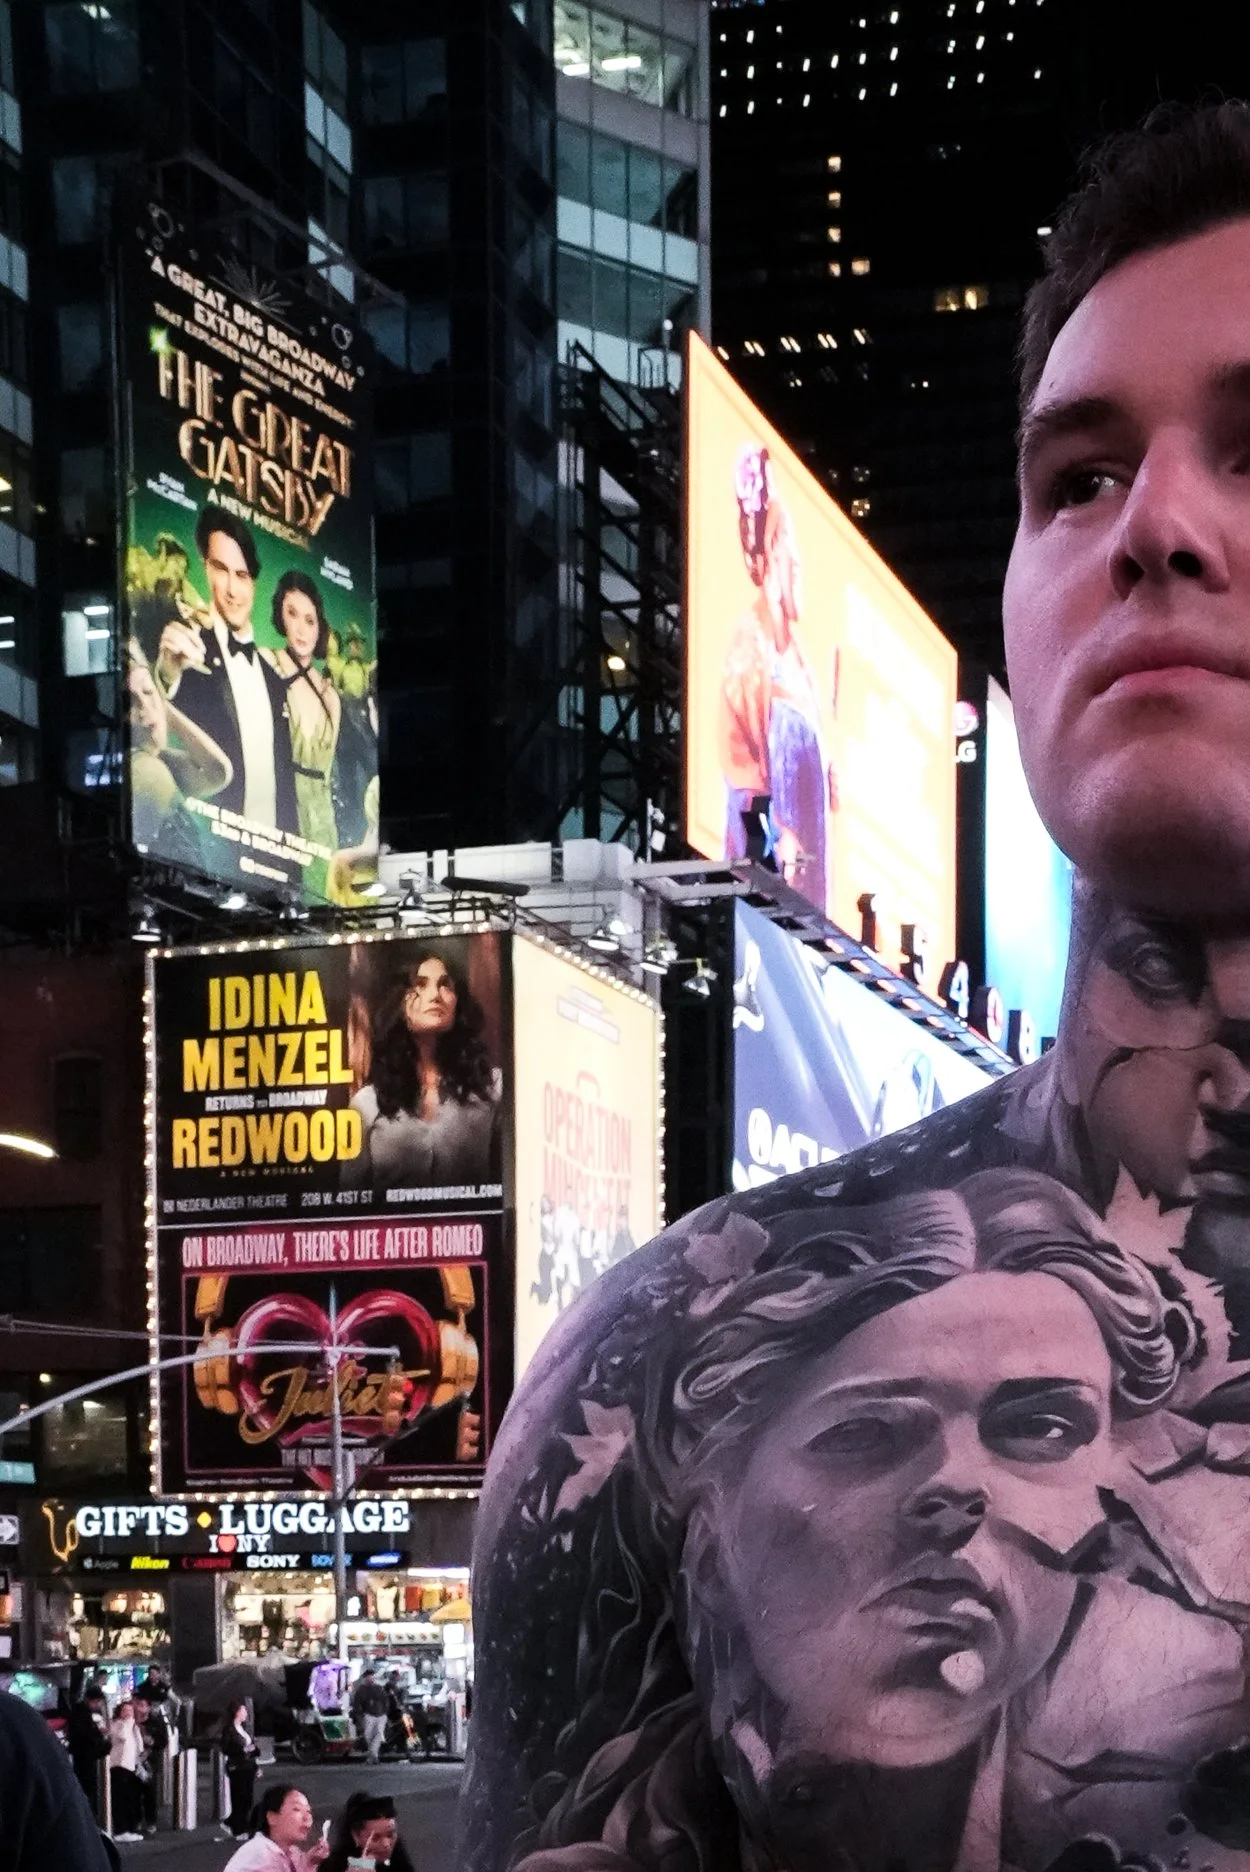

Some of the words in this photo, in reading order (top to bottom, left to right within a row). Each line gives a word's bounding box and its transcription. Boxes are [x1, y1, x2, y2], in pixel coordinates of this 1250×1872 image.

[167, 264, 230, 318] GREAT,
[233, 303, 265, 338] BIG
[267, 324, 356, 391] BROADWAY
[194, 302, 326, 396] EXTRAVAGANZA
[158, 347, 225, 430] THE
[232, 390, 352, 498] GREAT
[178, 418, 335, 536] GATSBY
[208, 970, 328, 1031] IDINA
[182, 1029, 355, 1093] MENZEL
[205, 1095, 256, 1113] RETURNS
[268, 1089, 328, 1108] BROADWAY
[543, 1080, 633, 1176] OPERATION
[172, 1108, 363, 1169] REDWOOD
[176, 1195, 245, 1213] NEDERLANDER
[247, 1193, 289, 1208] THEATRE
[360, 1189, 374, 1203] ST
[386, 1184, 503, 1203] REDWOODMUSICAL.COM
[182, 1236, 204, 1268] ON
[206, 1232, 289, 1267] BROADWAY,
[293, 1229, 350, 1263] THERE'S
[353, 1228, 381, 1260] LIFE
[383, 1226, 429, 1259] AFTER
[432, 1224, 484, 1257] ROMEO
[75, 1505, 189, 1537] GIFTS
[219, 1500, 410, 1534] LUGGAGE
[236, 1533, 271, 1553] NY
[130, 1556, 170, 1570] Nikon
[246, 1554, 301, 1569] SONY
